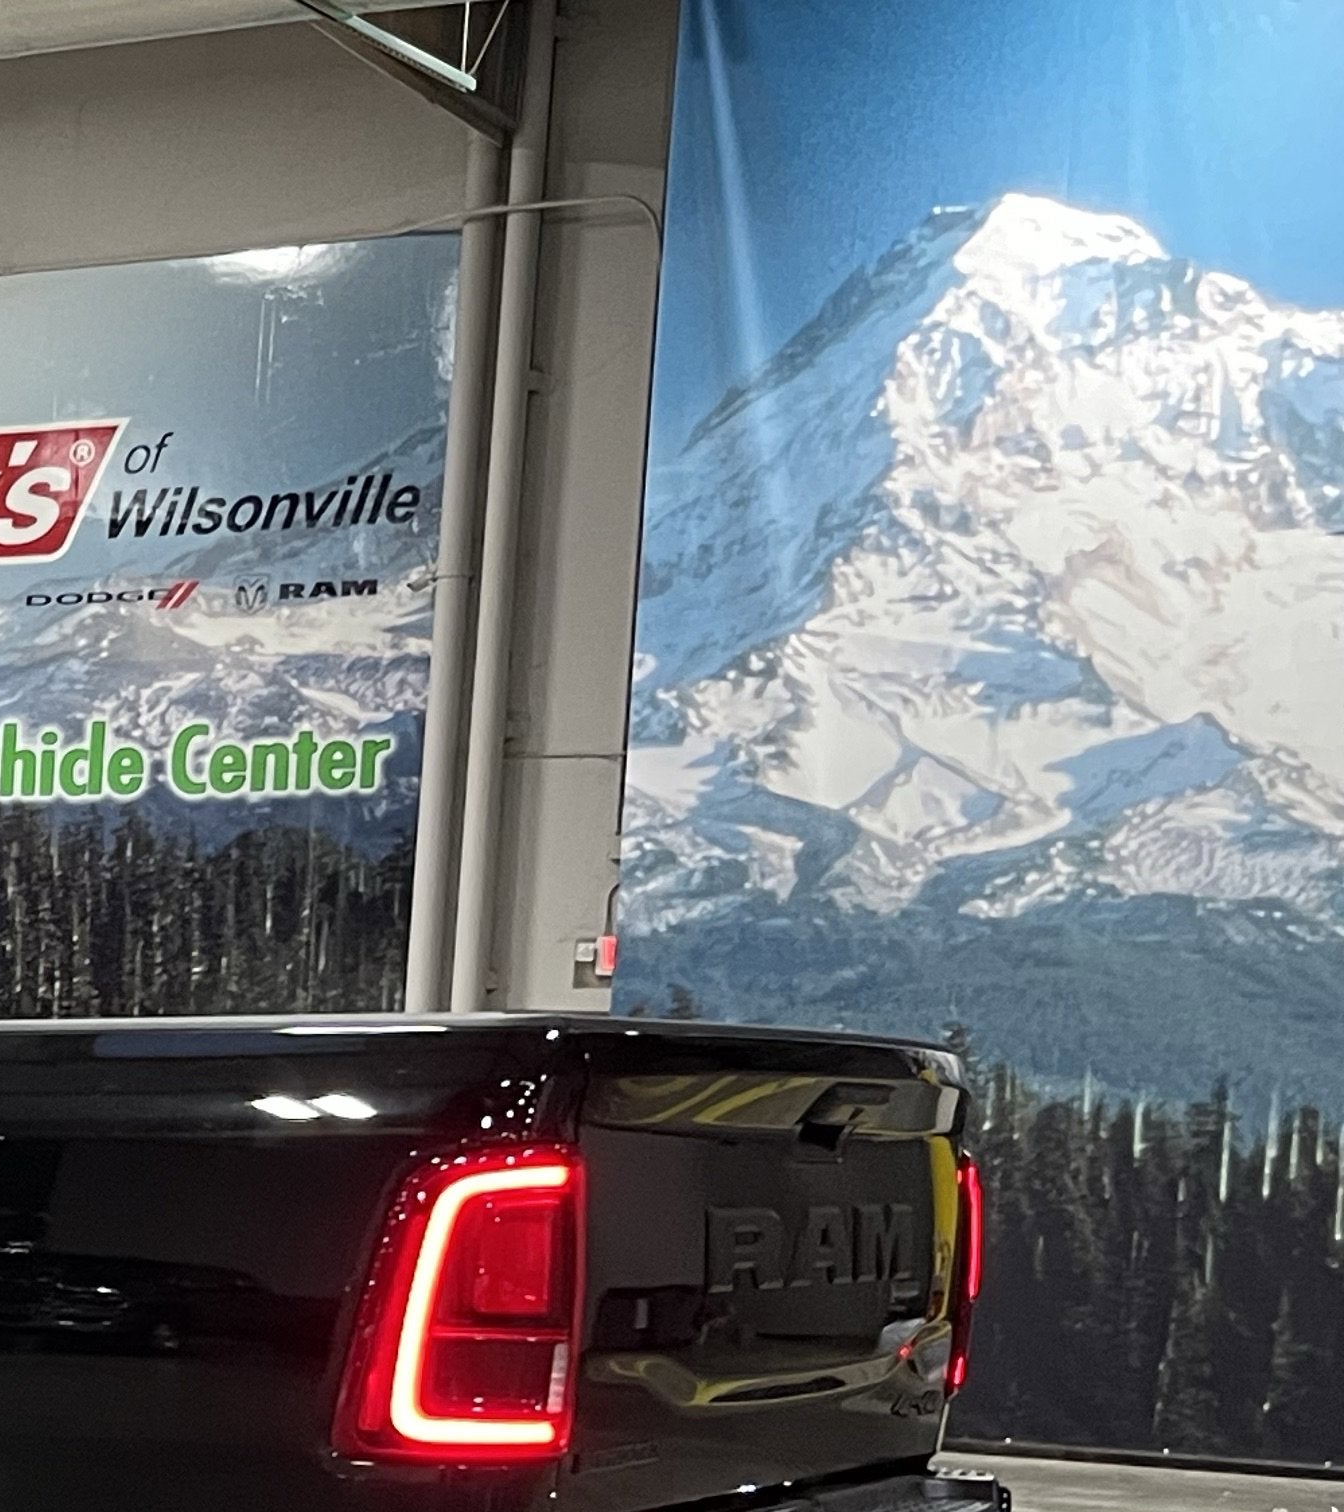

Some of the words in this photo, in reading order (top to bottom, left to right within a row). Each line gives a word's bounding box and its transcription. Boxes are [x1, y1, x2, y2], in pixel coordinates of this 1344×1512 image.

[123, 432, 174, 474] of
[108, 474, 420, 541] Wilsonville
[279, 579, 378, 600] RAM
[172, 723, 391, 793] Center
[705, 1204, 913, 1294] RAM
